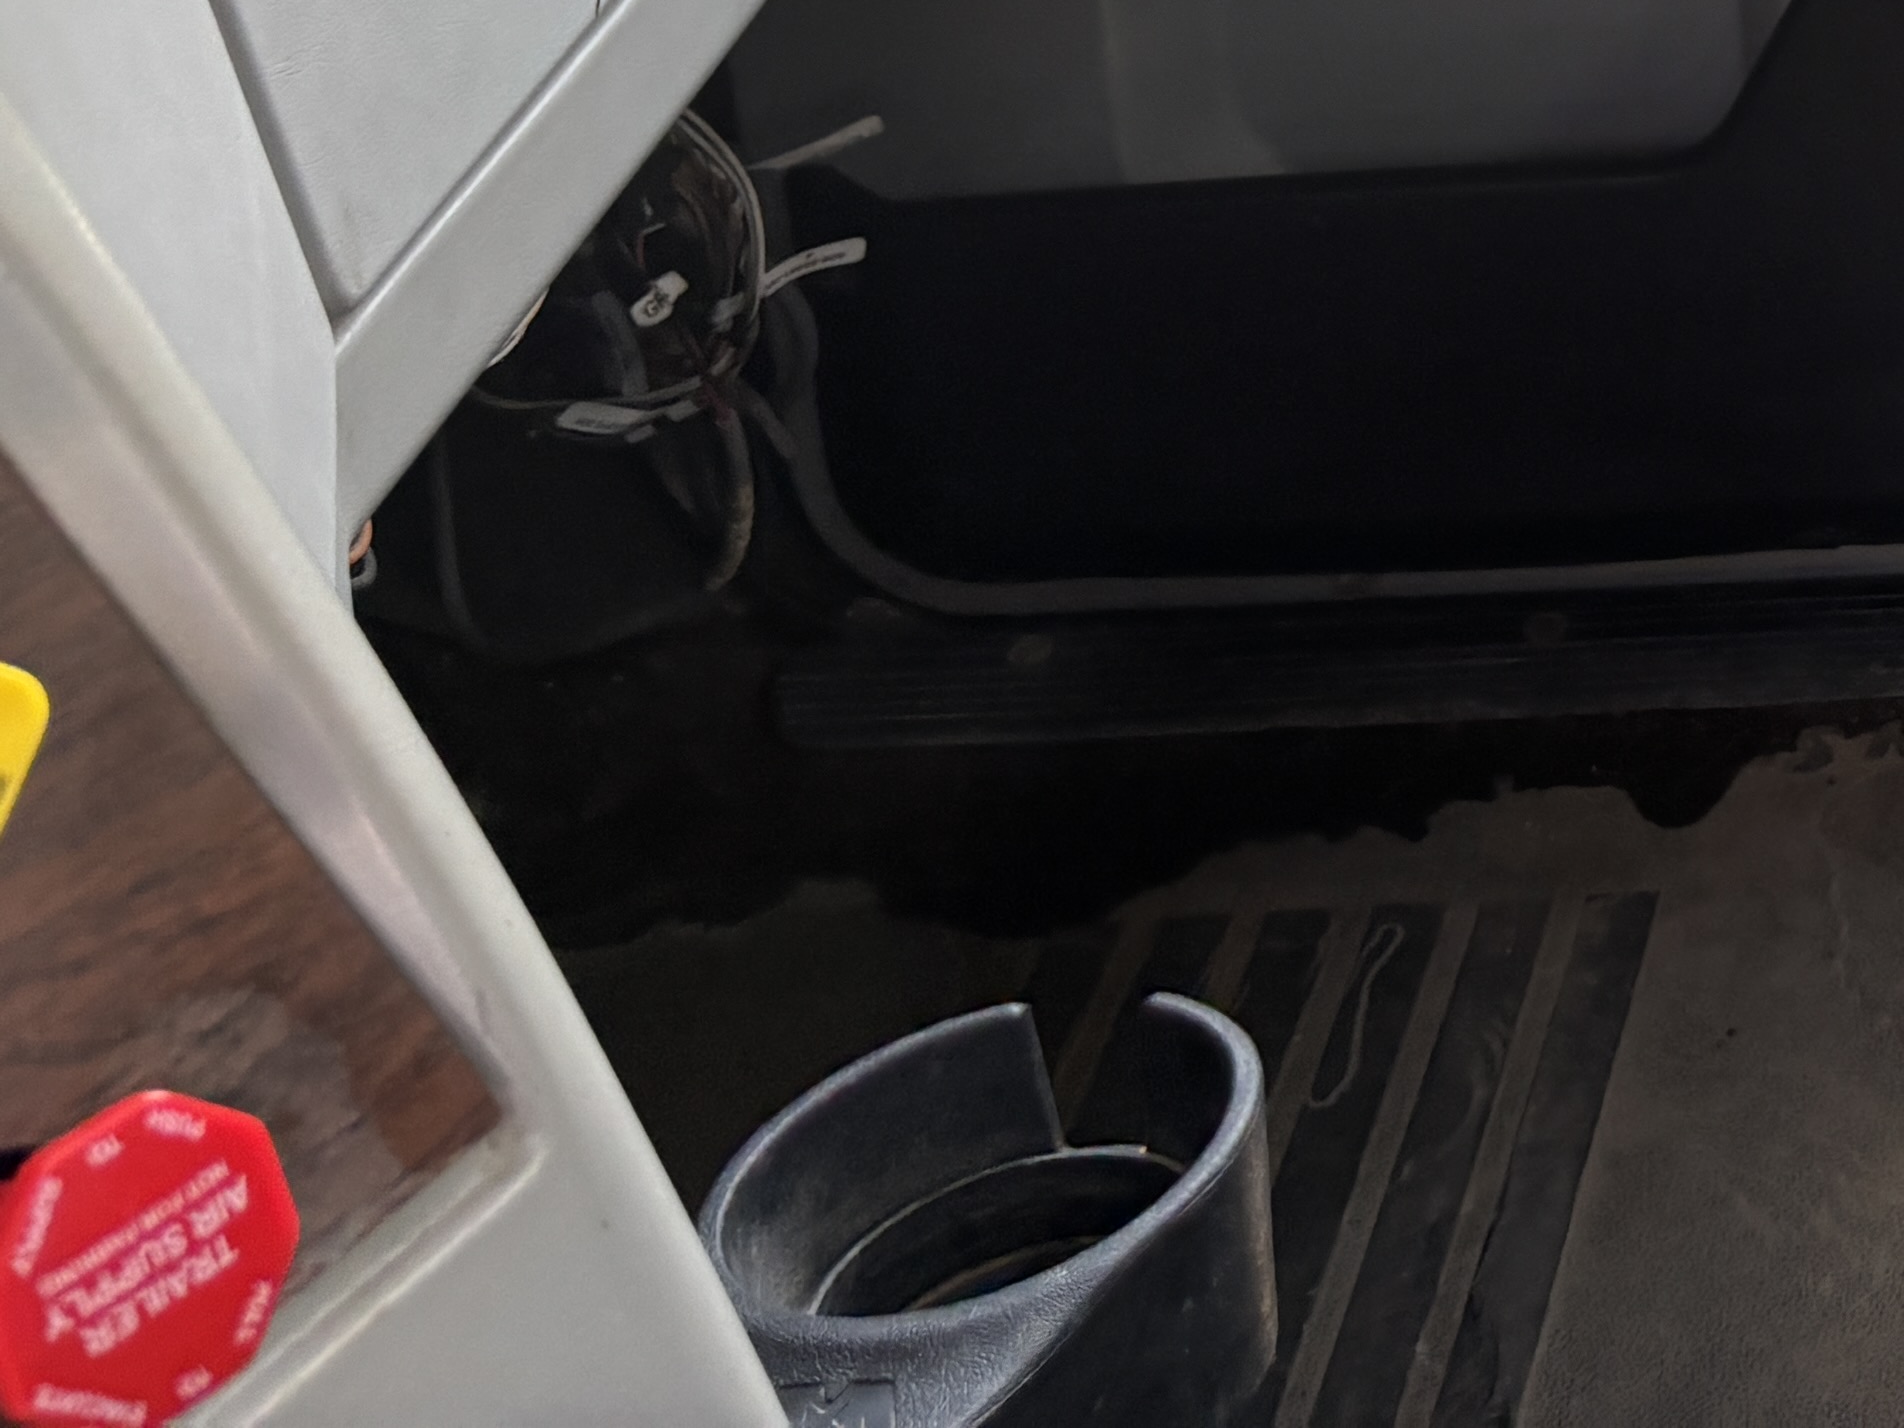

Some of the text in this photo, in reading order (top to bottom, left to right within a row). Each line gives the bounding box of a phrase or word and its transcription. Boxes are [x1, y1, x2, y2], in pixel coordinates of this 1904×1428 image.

[182, 1158, 230, 1200] NOT
[44, 1172, 248, 1344] AIR SUPPLY
[77, 1232, 240, 1359] TRAILER
